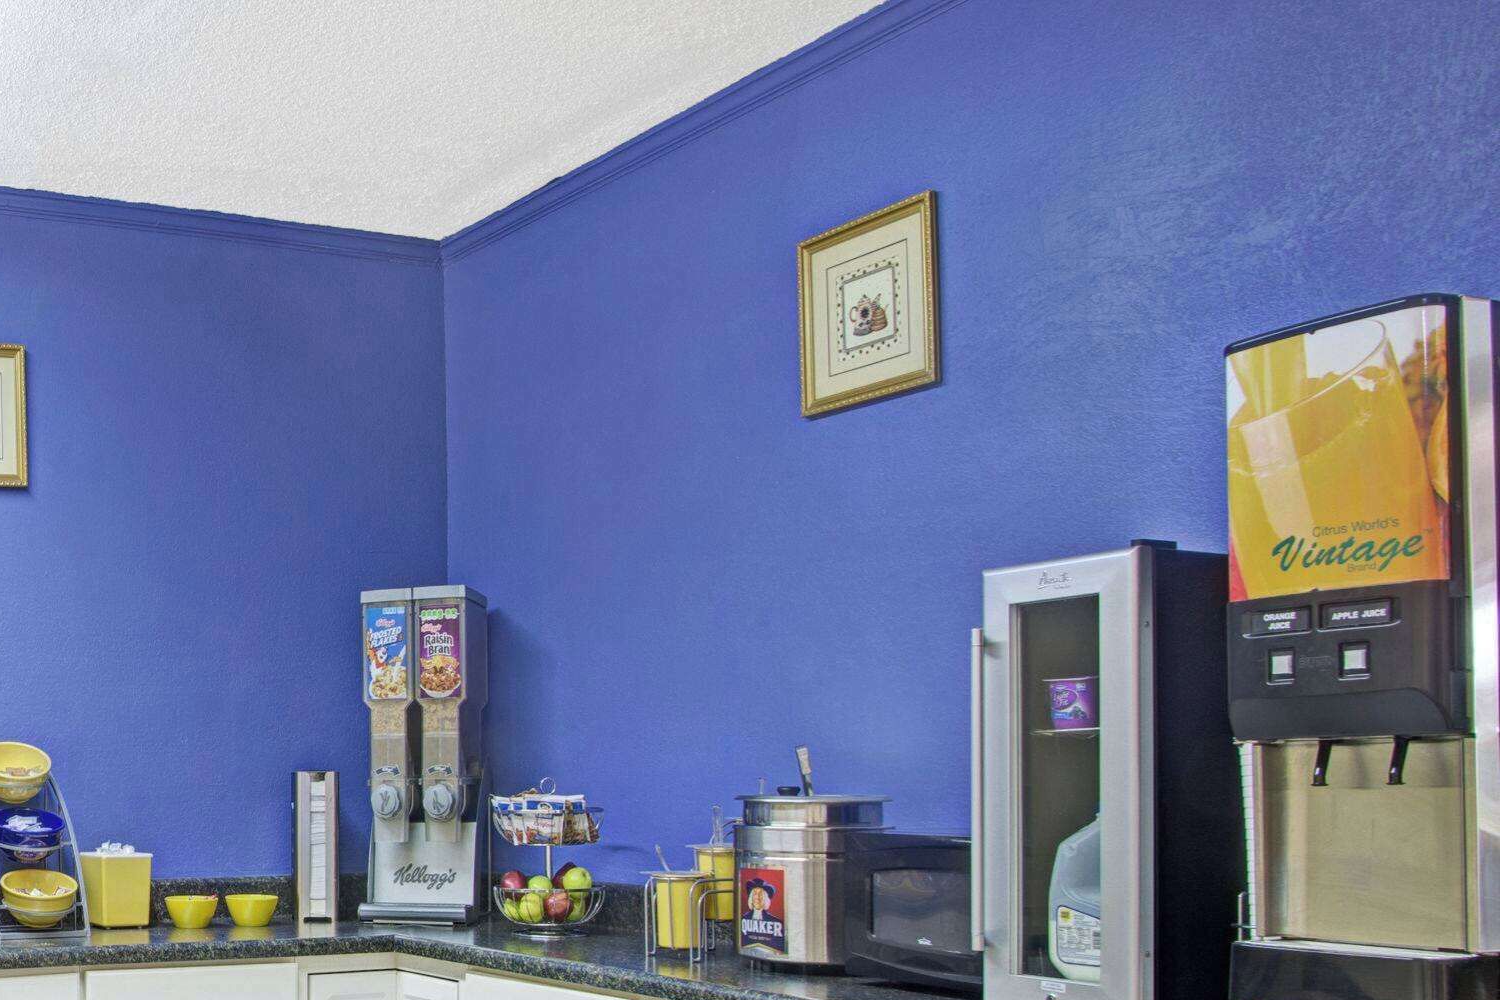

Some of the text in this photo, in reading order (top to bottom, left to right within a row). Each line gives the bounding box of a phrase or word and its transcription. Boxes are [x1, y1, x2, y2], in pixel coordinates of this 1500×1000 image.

[1312, 517, 1399, 538] Citrus World's
[1272, 534, 1424, 571] Vintage
[1347, 563, 1377, 573] Brand
[1263, 611, 1297, 621] ORANGE
[1331, 608, 1387, 620] APPLE JUICE
[1267, 621, 1291, 630] JUICE
[424, 633, 453, 647] Raisin
[428, 644, 451, 655] Bran
[393, 863, 457, 890] Kellogg's
[741, 918, 783, 937] QUAKER
